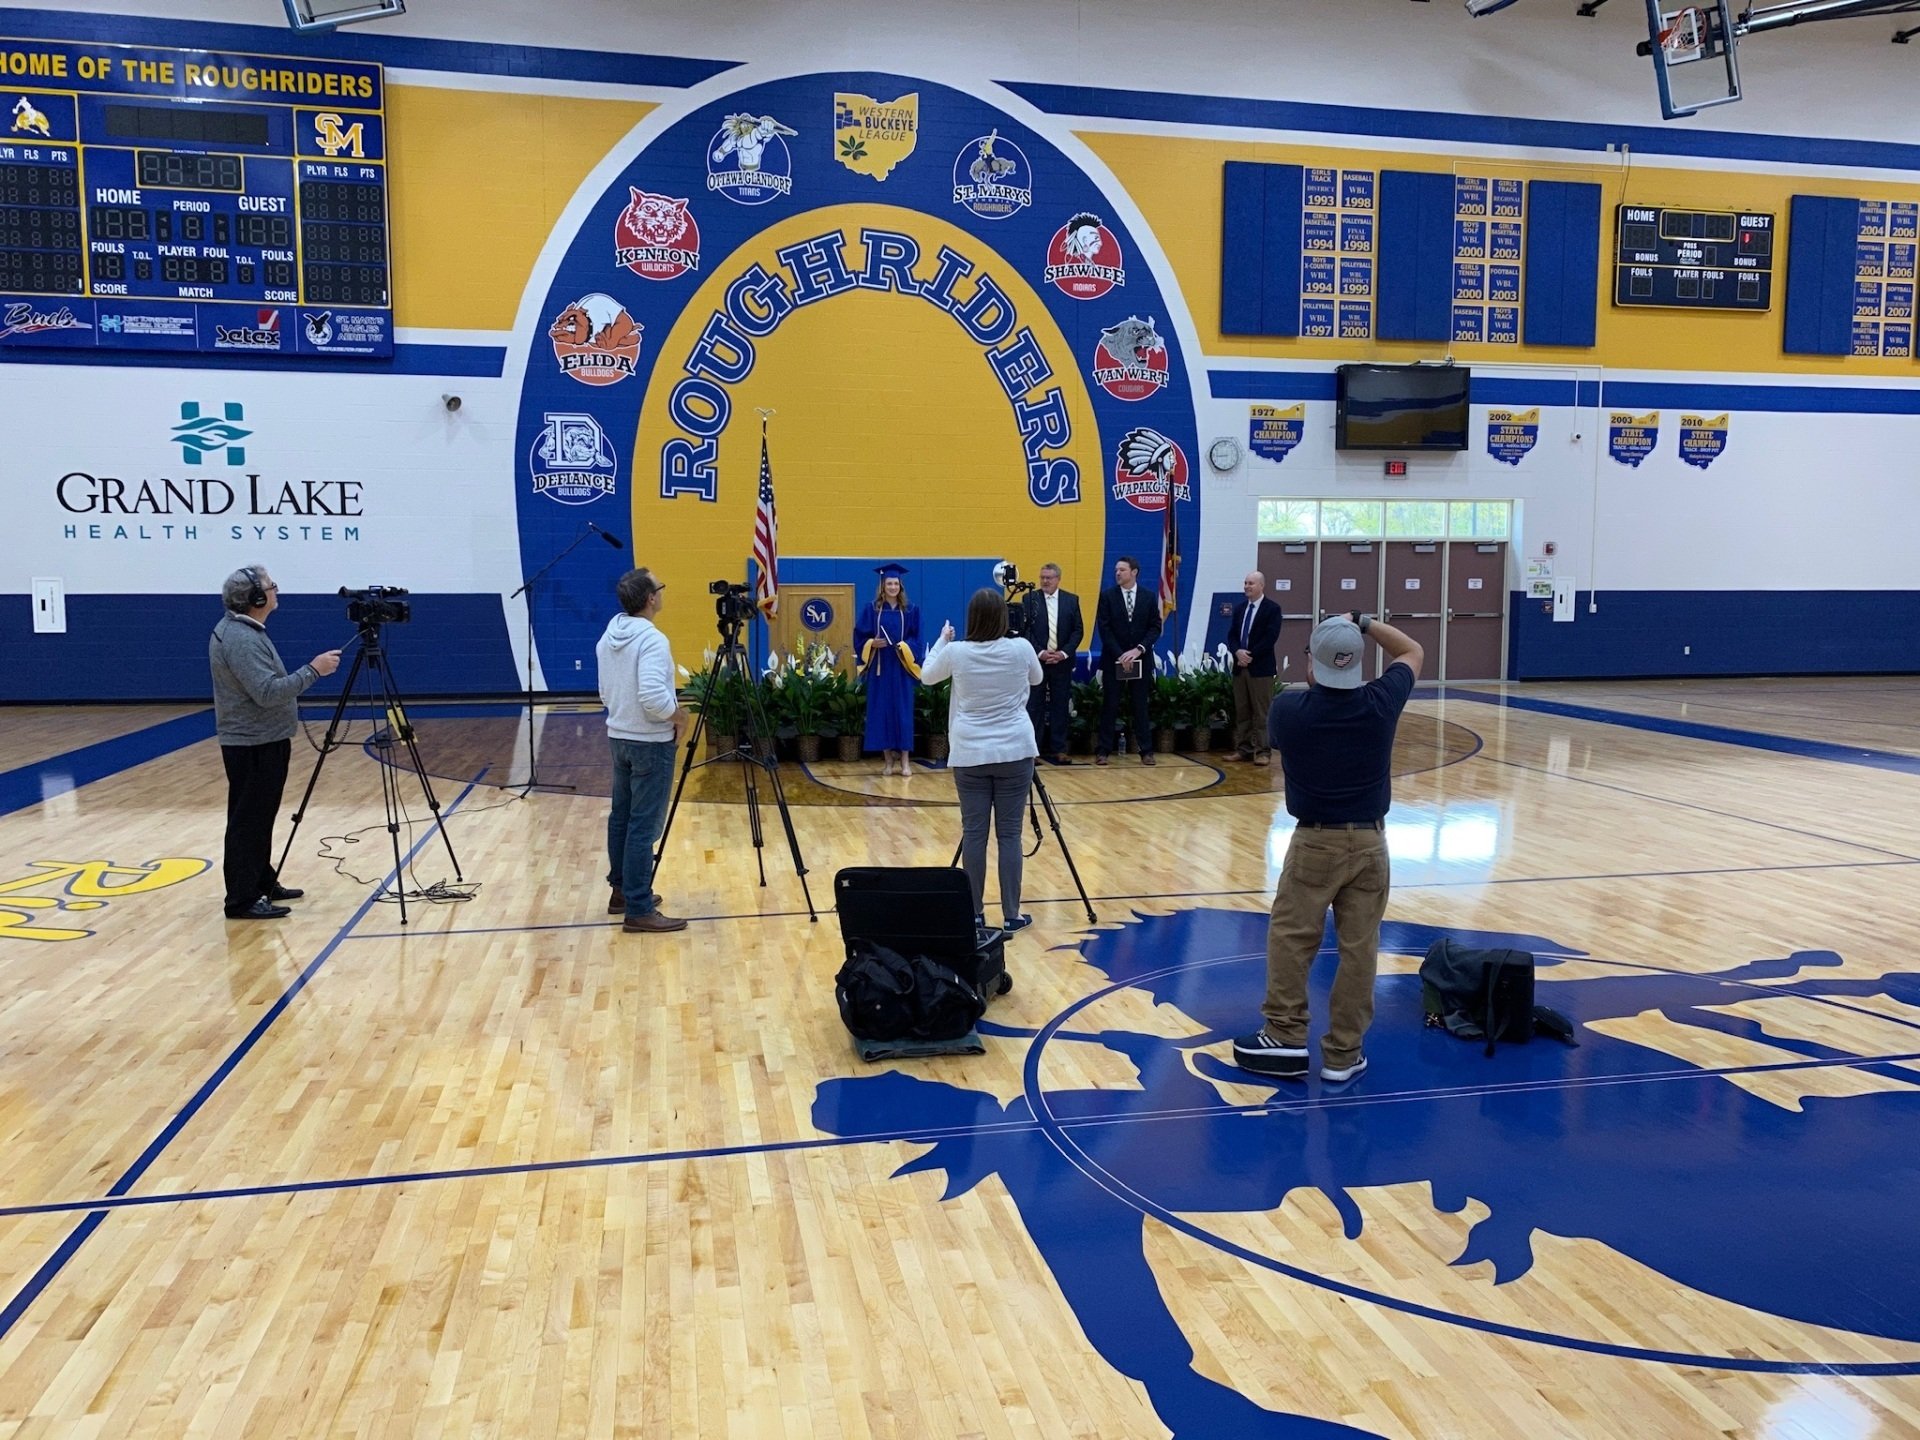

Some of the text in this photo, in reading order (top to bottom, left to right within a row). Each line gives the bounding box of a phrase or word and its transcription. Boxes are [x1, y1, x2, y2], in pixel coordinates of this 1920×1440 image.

[77, 56, 112, 79] OF
[121, 59, 175, 85] THE
[185, 63, 373, 98] ROUGHRIDERS
[859, 105, 914, 119] WESTERN
[865, 116, 914, 131] BUCKEYE
[314, 112, 365, 158] SM
[858, 129, 907, 142] LEAGUE
[24, 149, 39, 160] FLS
[51, 150, 68, 162] PTS
[306, 164, 375, 179] PLYR FLS PTS
[1344, 174, 1372, 182] BASEBALL
[739, 187, 761, 197] TITANS
[1307, 185, 1334, 193] DISTRICT
[1349, 186, 1367, 194] WBL
[96, 188, 142, 205] HOME
[954, 185, 1031, 206] ST. MARYS
[1308, 195, 1334, 206] 1993
[173, 200, 211, 213] PERIOD
[238, 196, 287, 213] GUEST
[973, 202, 1012, 213] ROUGHRIDERS
[1345, 197, 1371, 208] 1998
[1459, 203, 1485, 214] 2000
[1494, 205, 1520, 217] 2001
[1342, 217, 1372, 225] VOLLEYBALL
[1627, 209, 1655, 222] HOME
[1304, 218, 1336, 226] BASKETBALL
[1740, 216, 1770, 228] GUEST
[1861, 225, 1884, 235] 2004
[1892, 227, 1915, 237] 2006
[1307, 239, 1333, 249] 1994
[1344, 241, 1370, 252] 1998
[1497, 238, 1514, 246] WBL
[91, 242, 294, 265] FOULS T.O.L. PLAYER FOUL T.O.L. FOULS
[1458, 246, 1484, 257] 2000
[1493, 248, 1519, 259] 2002
[1677, 249, 1703, 258] PERIOD
[616, 248, 699, 270] KENTON
[1635, 253, 1659, 262] BONUS
[1734, 258, 1757, 266] BONUS
[641, 262, 675, 273] WILDCATS
[1858, 266, 1881, 275] 2004
[1890, 268, 1913, 277] 2006
[1044, 264, 1125, 287] SHAWNEE
[1310, 272, 1329, 280] WBL
[1631, 268, 1760, 281] FOULS PLAYER FOULS FOULS
[93, 283, 297, 302] SCORE MATCH SCORE
[1072, 282, 1097, 293] INDIANS
[1306, 282, 1333, 293] 1994
[1343, 284, 1369, 294] 1999
[1456, 288, 1482, 299] 2000
[1492, 290, 1517, 301] 2003
[1856, 306, 1879, 315] 2004
[1888, 307, 1911, 317] 2007
[350, 316, 384, 325] MARYS
[1309, 314, 1328, 322] WBL
[1460, 320, 1477, 328] WBL
[1305, 325, 1332, 336] 1997
[1342, 327, 1368, 338] 2000
[1455, 330, 1481, 341] 2001
[1490, 332, 1516, 343] 2003
[1854, 346, 1877, 355] 2005
[1885, 347, 1908, 356] 2008
[560, 353, 636, 376] ELIDA
[660, 228, 1081, 508] ROUGHRIDERS
[581, 368, 615, 378] BULLDOGS
[1093, 368, 1169, 388] VAN WERT
[1118, 384, 1145, 393] COUGARS
[1252, 408, 1275, 416] 1977
[1489, 413, 1512, 421] 2002
[1263, 421, 1289, 430] STATE
[1611, 416, 1633, 424] 2003
[1681, 418, 1703, 427] 2010
[1253, 430, 1297, 439] CHAMPION
[1500, 426, 1524, 434] STATE
[1621, 429, 1645, 437] STATE
[1691, 431, 1714, 439] STATE
[1490, 434, 1534, 443] CHAMPIONS
[1613, 437, 1652, 446] CHAMPION
[1683, 439, 1721, 448] CHAMPION
[533, 473, 616, 494] DEFIANCE
[56, 472, 364, 517] GRAND LAKE
[558, 487, 591, 497] BULLDOGS
[1112, 481, 1191, 502] WAPAKONTA
[1138, 495, 1166, 504] REDSKINS
[64, 524, 359, 541] HEALTH SYSTEM
[806, 604, 827, 623] SM
